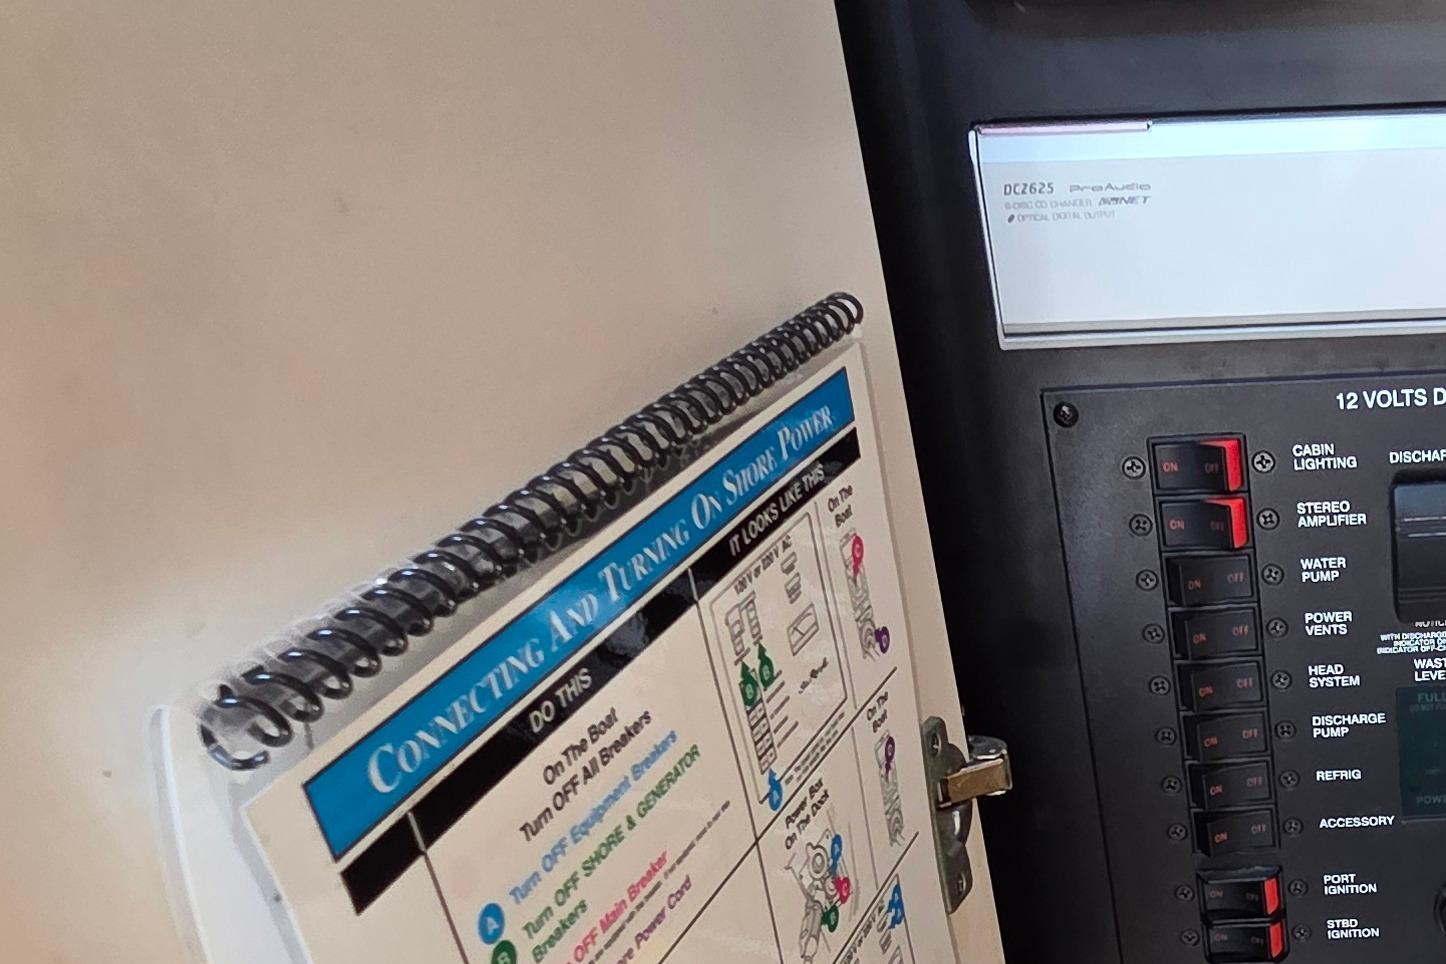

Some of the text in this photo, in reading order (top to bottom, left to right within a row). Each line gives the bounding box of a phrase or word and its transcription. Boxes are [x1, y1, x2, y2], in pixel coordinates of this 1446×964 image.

[1336, 393, 1358, 409] 12
[1363, 389, 1428, 408] VOLTS
[1292, 444, 1334, 457] CABIN
[1294, 457, 1357, 470] LIGHTING
[729, 463, 824, 555] IT LOOKS LIKE THIS
[1297, 501, 1350, 514] STEREO
[1298, 514, 1367, 527] AMPLIFIER
[1301, 557, 1346, 570] WATER
[1302, 571, 1340, 582] PUMP
[1305, 611, 1352, 623] POWER
[1305, 625, 1348, 635] VENTS
[1309, 664, 1344, 675] HEAD
[1309, 676, 1360, 688] SYSTEM
[529, 668, 591, 732] DO THIS
[1312, 713, 1386, 726] DISCHARGE
[1313, 727, 1349, 738] PUMP
[543, 707, 617, 784] On The Boat
[519, 711, 650, 841] Turn OFF All Breakers
[1316, 770, 1361, 781] REFRIG
[509, 730, 676, 903] Turn OFF Equipment Breakers
[1320, 816, 1394, 828] ACCESSORY
[522, 745, 699, 938] Turn OFF SHORE & GENERATOR
[1324, 874, 1356, 884] PORT
[1324, 884, 1377, 895] IGNITION
[573, 927, 597, 962] OFF
[599, 899, 627, 933] Main
[626, 851, 666, 901] Breaker
[634, 907, 665, 948] Power
[667, 875, 691, 909] Cord
[1327, 919, 1358, 928] STBD
[532, 900, 586, 963] Breakers
[1328, 928, 1379, 939] IGNITION
